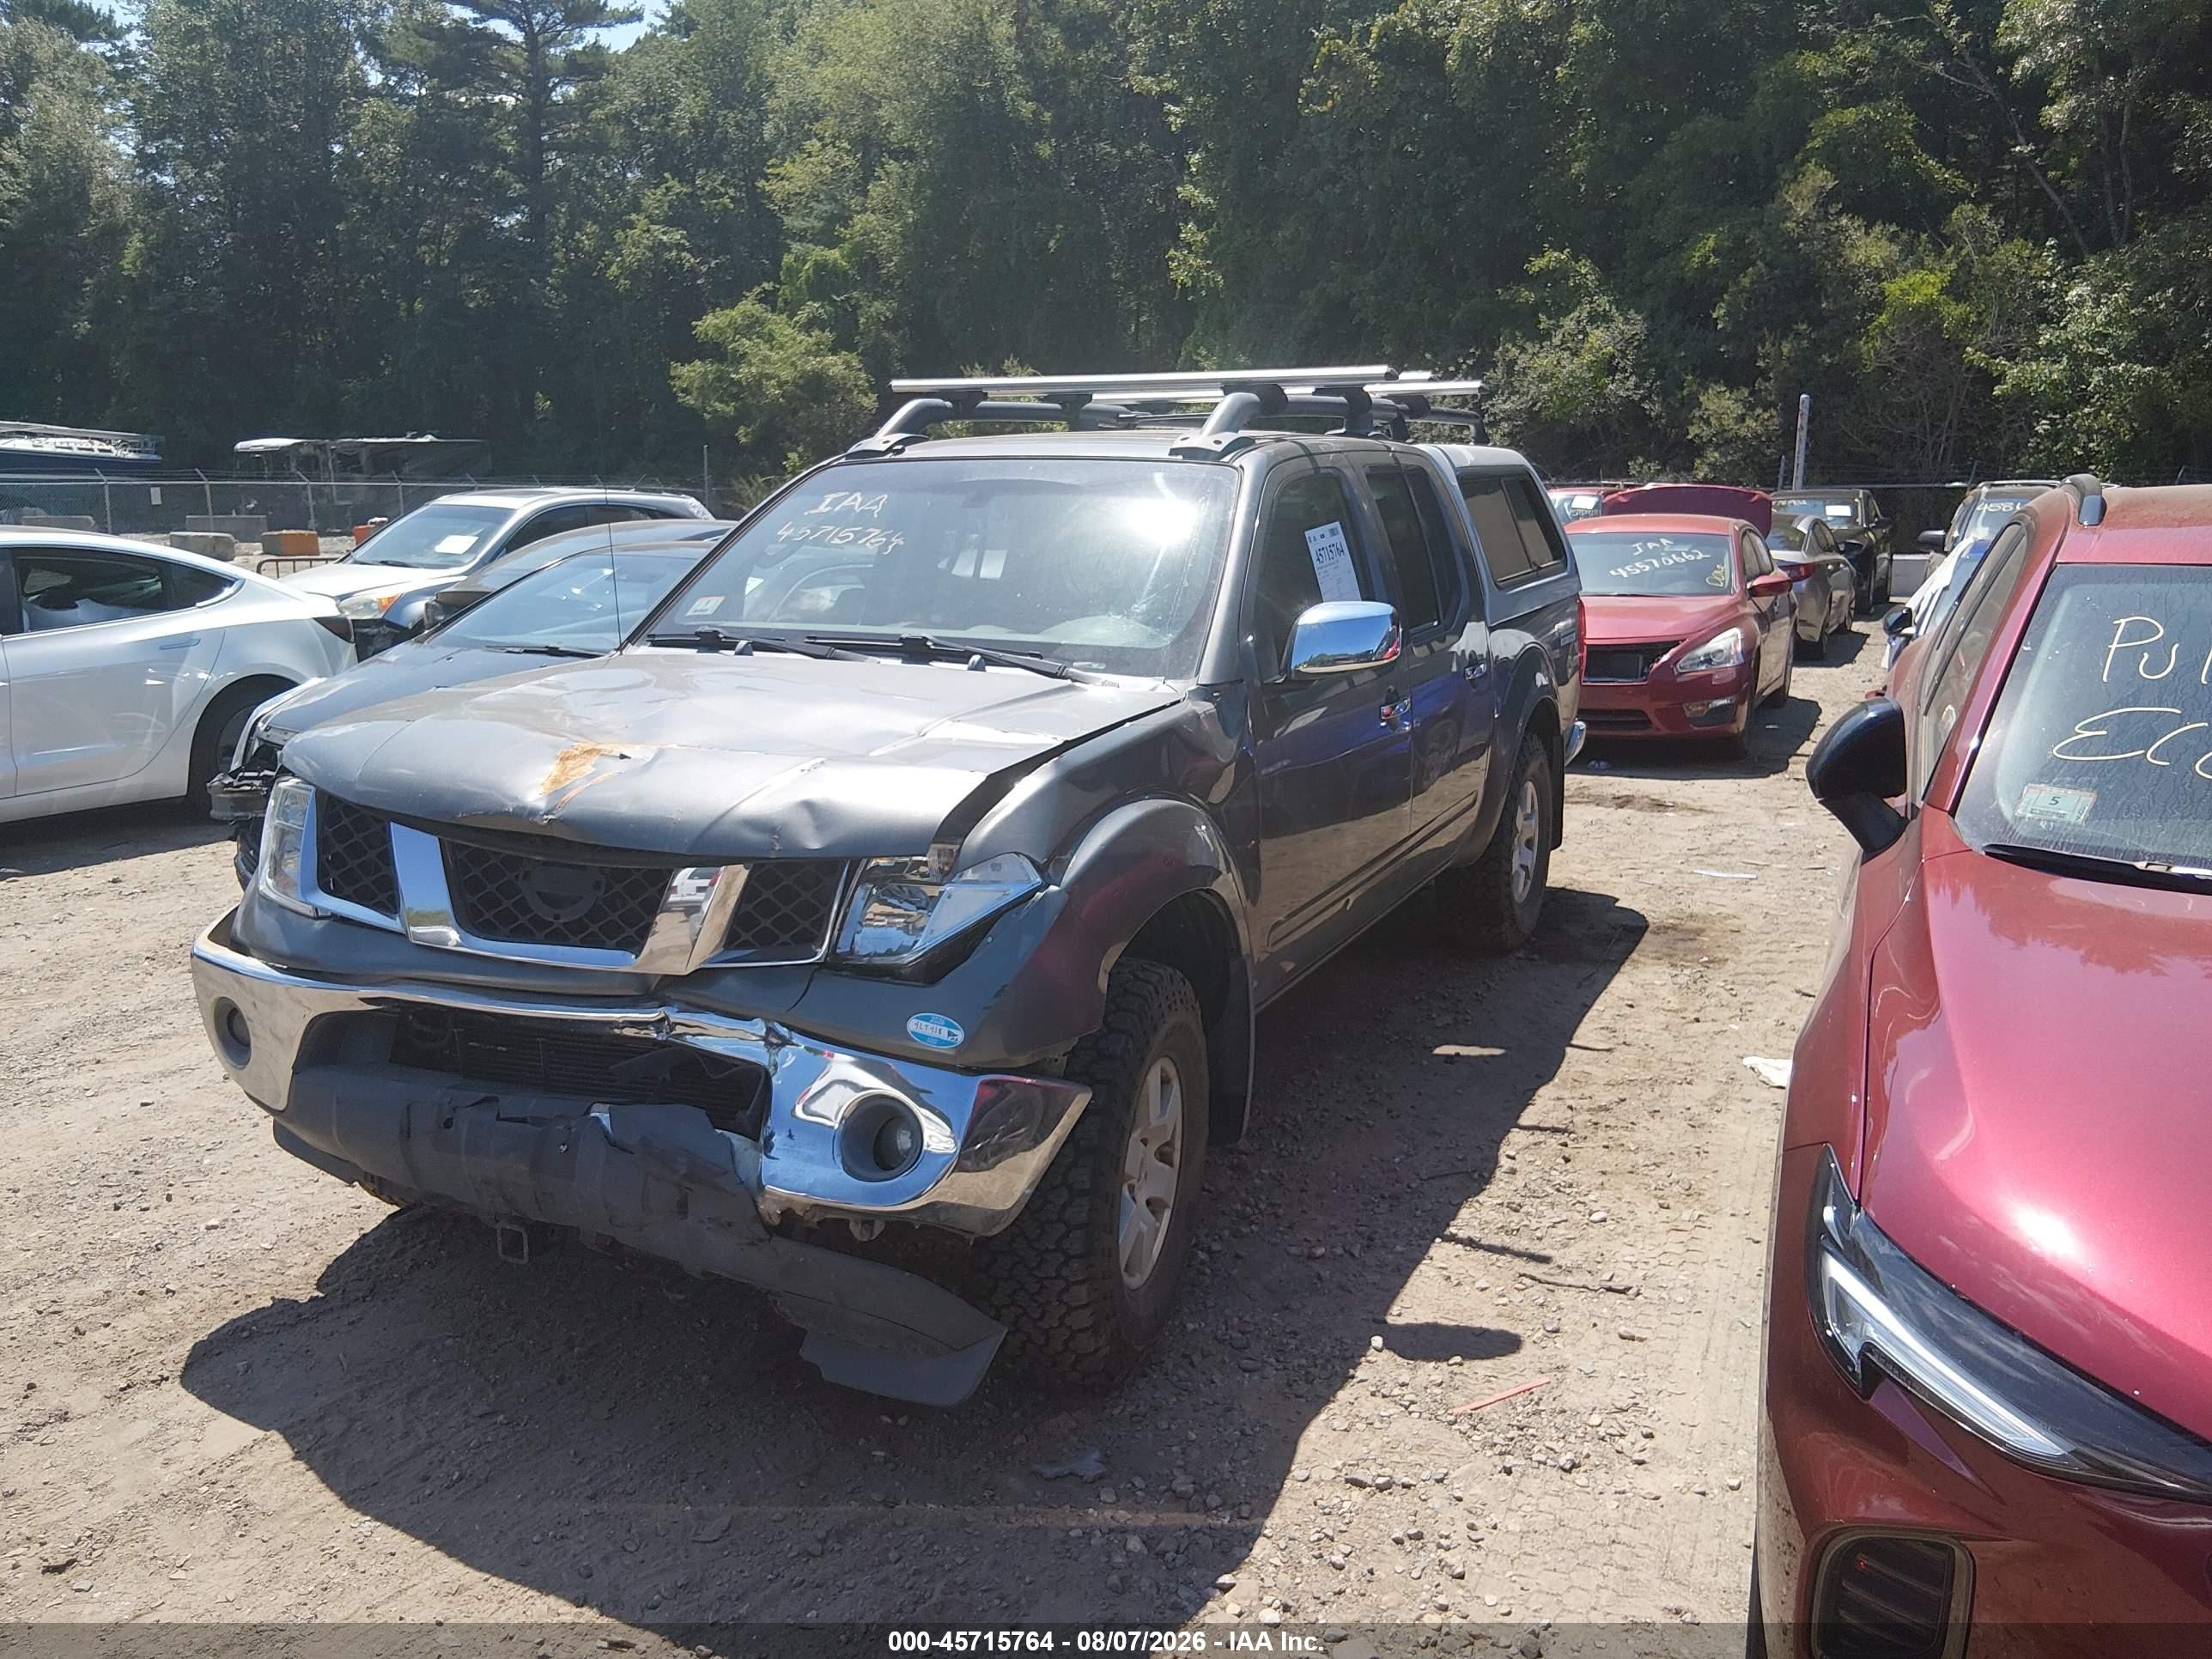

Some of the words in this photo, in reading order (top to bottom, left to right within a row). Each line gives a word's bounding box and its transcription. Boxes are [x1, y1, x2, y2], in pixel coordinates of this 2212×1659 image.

[804, 492, 879, 518] IAA
[1315, 541, 1346, 564] 45715764
[1608, 550, 1711, 578] 45570662
